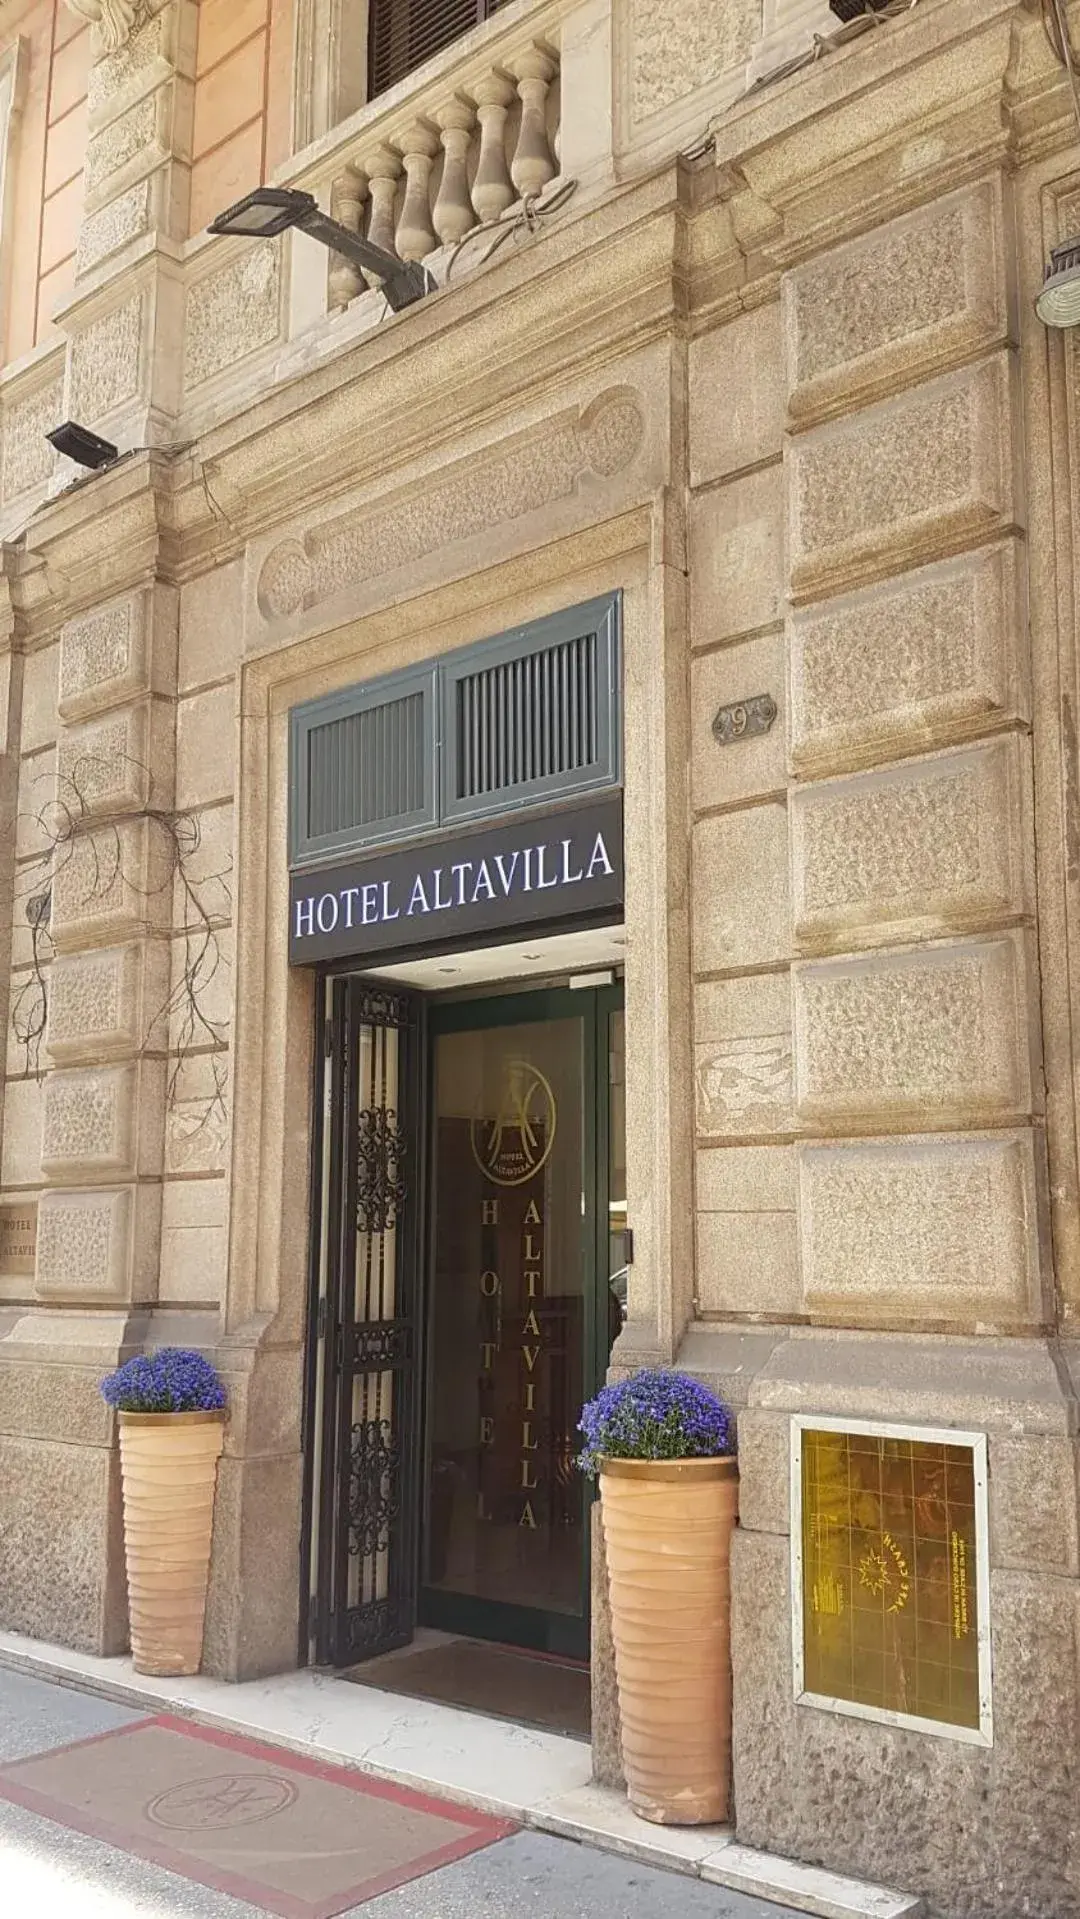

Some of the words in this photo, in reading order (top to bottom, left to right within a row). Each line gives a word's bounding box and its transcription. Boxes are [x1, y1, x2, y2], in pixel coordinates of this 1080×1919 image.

[731, 706, 747, 735] 9
[294, 880, 400, 938] HOTEL
[405, 831, 615, 915] ALTAVILLA
[4, 1219, 31, 1231] HOTEL
[519, 1199, 542, 1529] ALTAVILLA
